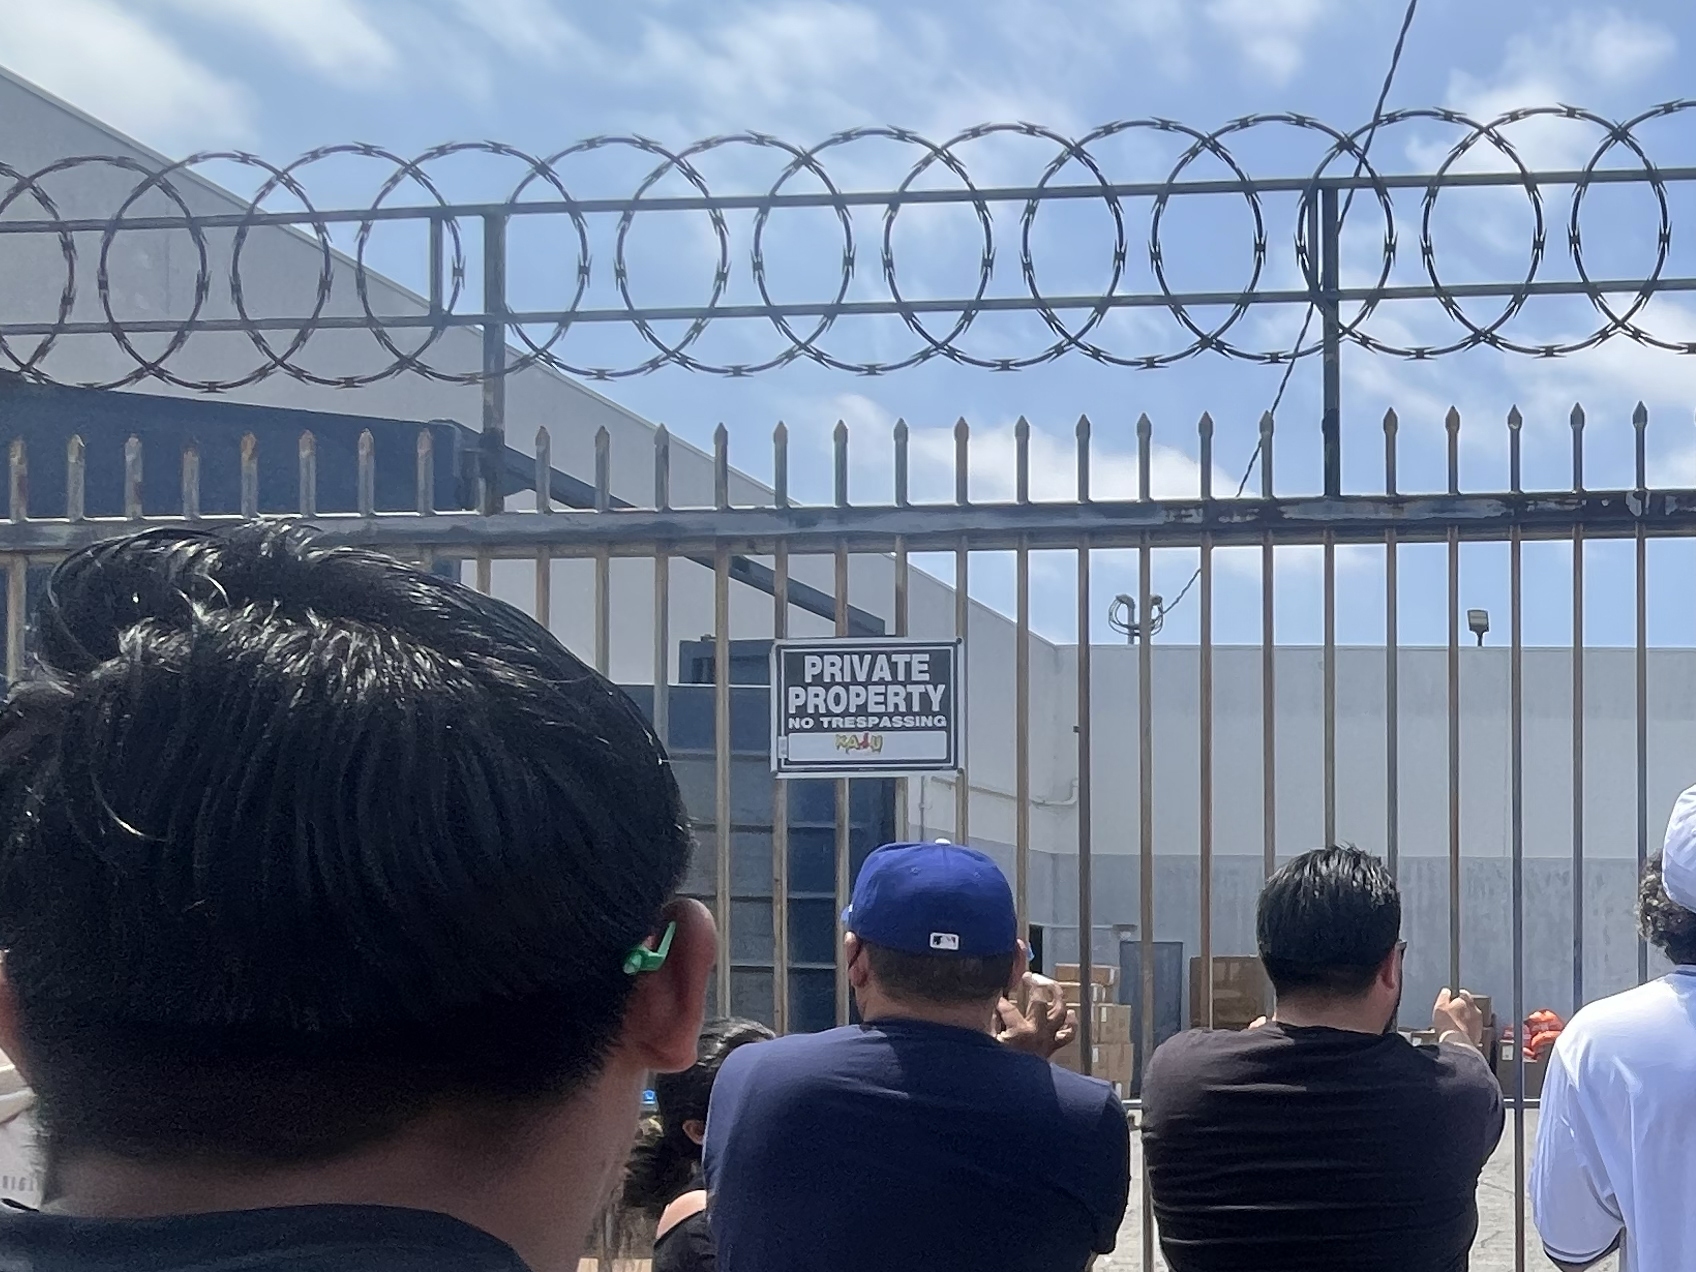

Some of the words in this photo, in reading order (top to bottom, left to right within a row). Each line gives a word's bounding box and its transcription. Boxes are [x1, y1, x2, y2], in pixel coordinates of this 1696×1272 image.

[804, 653, 930, 683] PRIVATE
[788, 684, 946, 714] PROPERTY
[788, 717, 815, 729] NO
[819, 715, 947, 729] TRESPASSING
